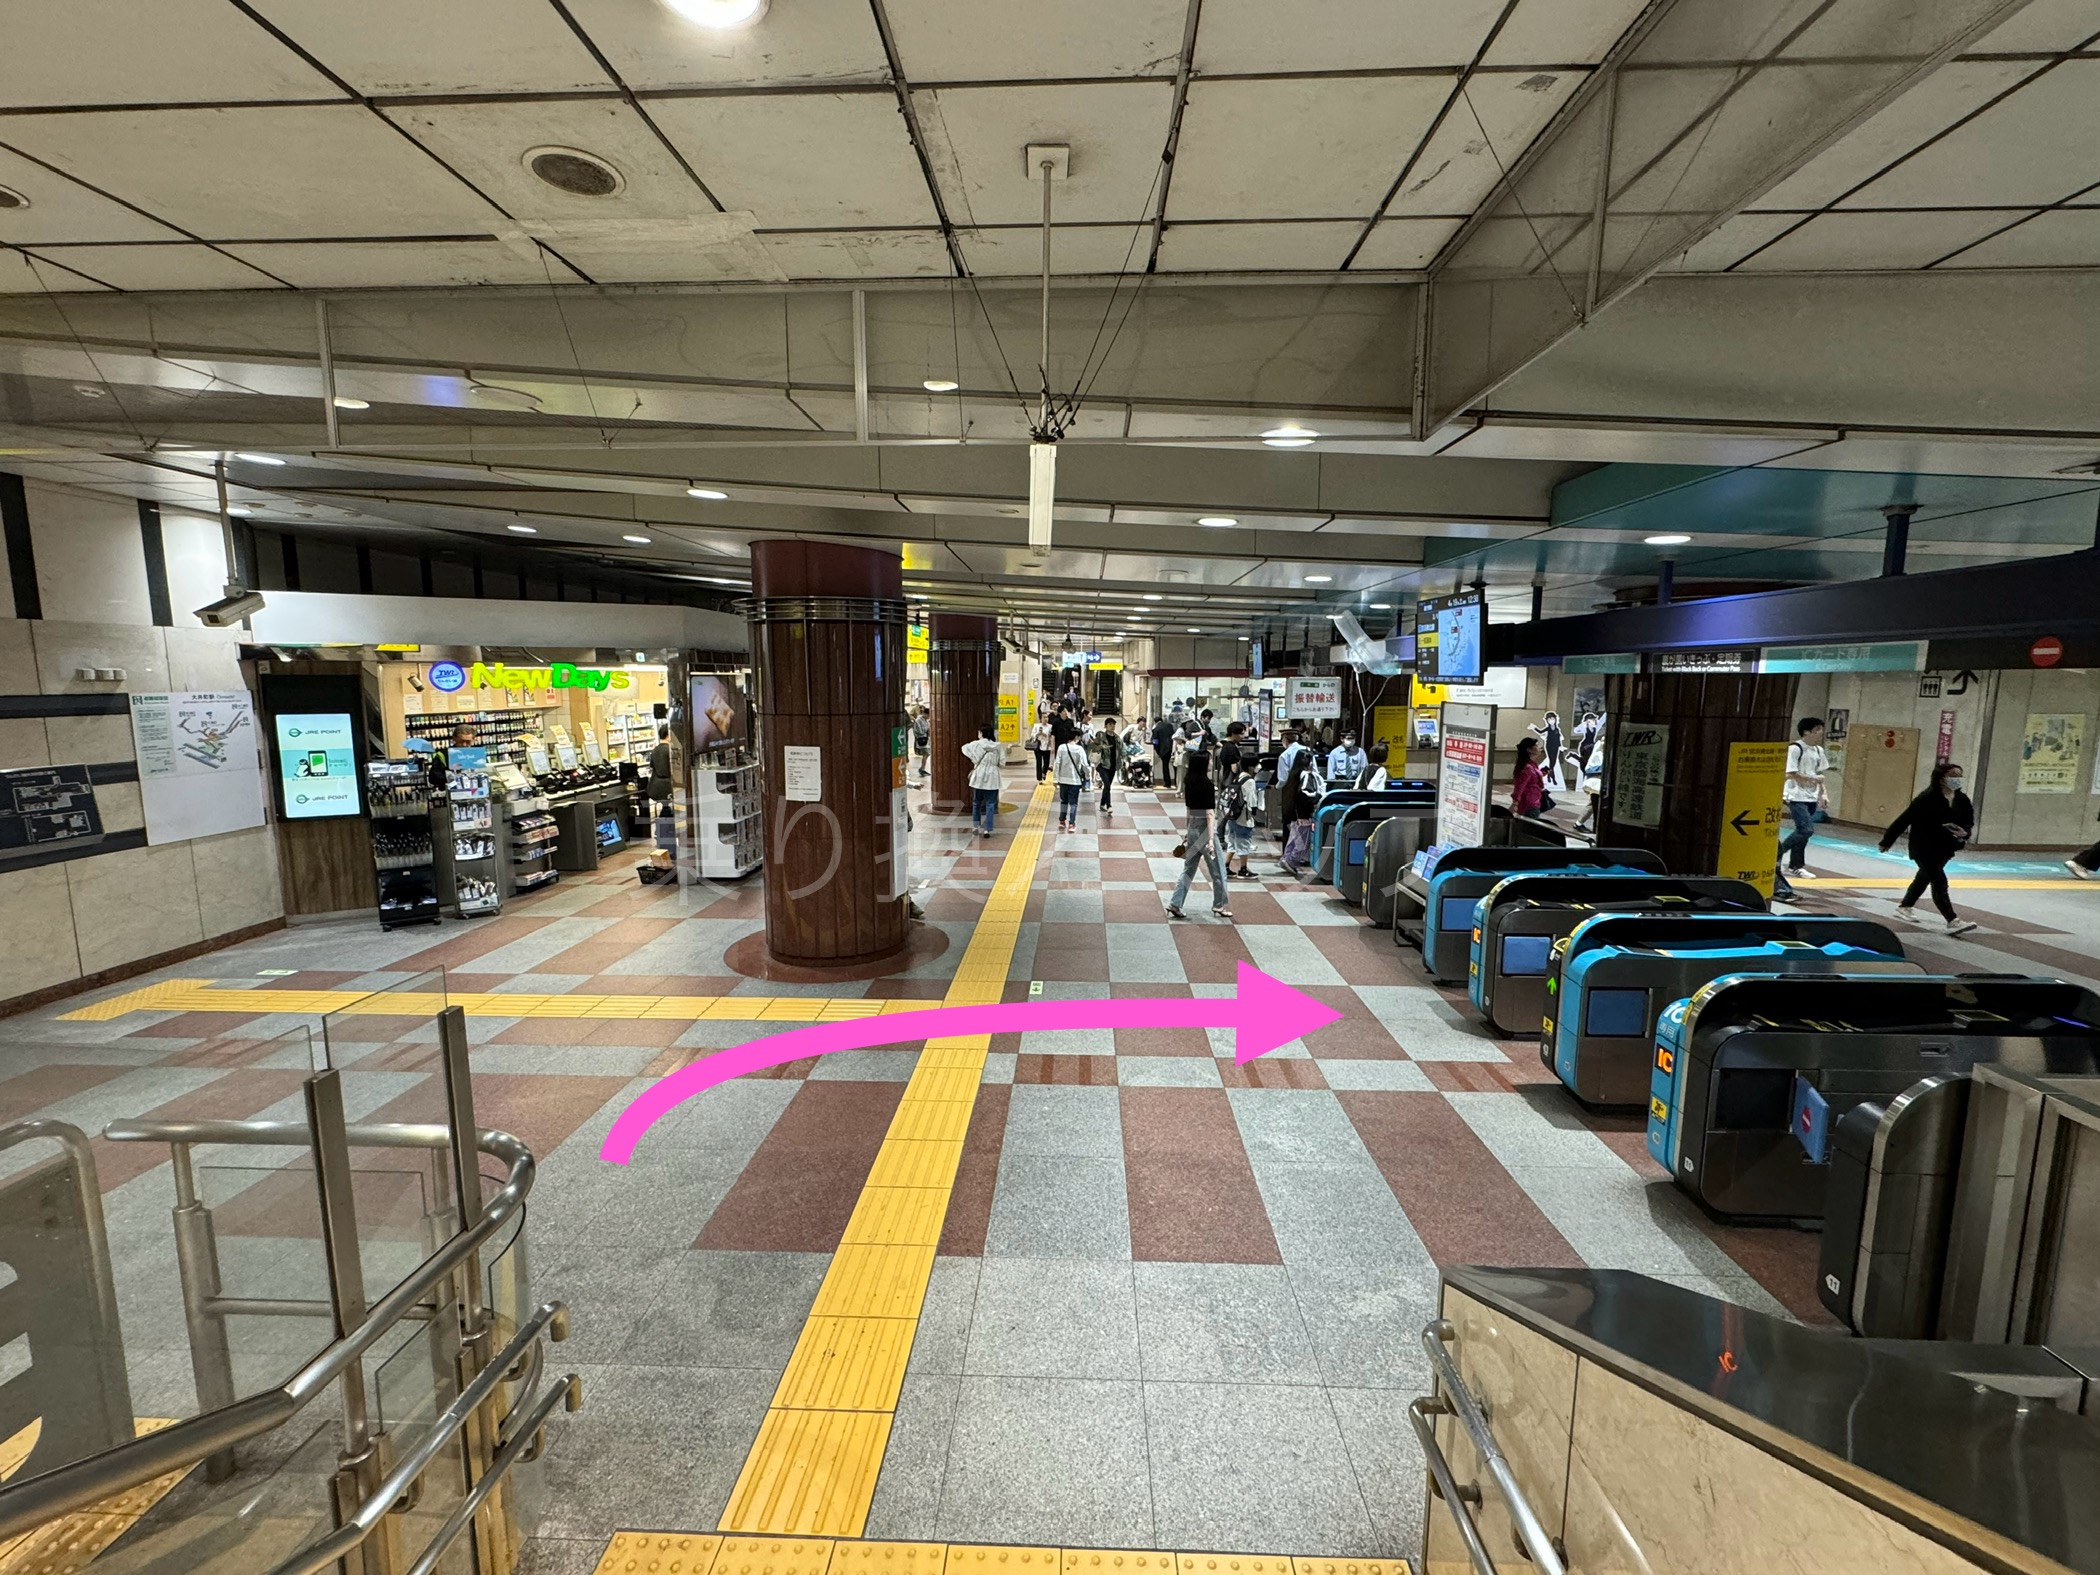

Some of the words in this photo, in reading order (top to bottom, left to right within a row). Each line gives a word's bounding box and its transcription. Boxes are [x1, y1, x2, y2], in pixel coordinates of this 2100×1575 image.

[471, 661, 631, 691] NewDays
[1295, 692, 1336, 704] 振替輸送
[1000, 723, 1010, 731] A2
[1941, 712, 1953, 735] 充電
[1657, 1047, 1674, 1074] IC
[1829, 1278, 1837, 1290] 11
